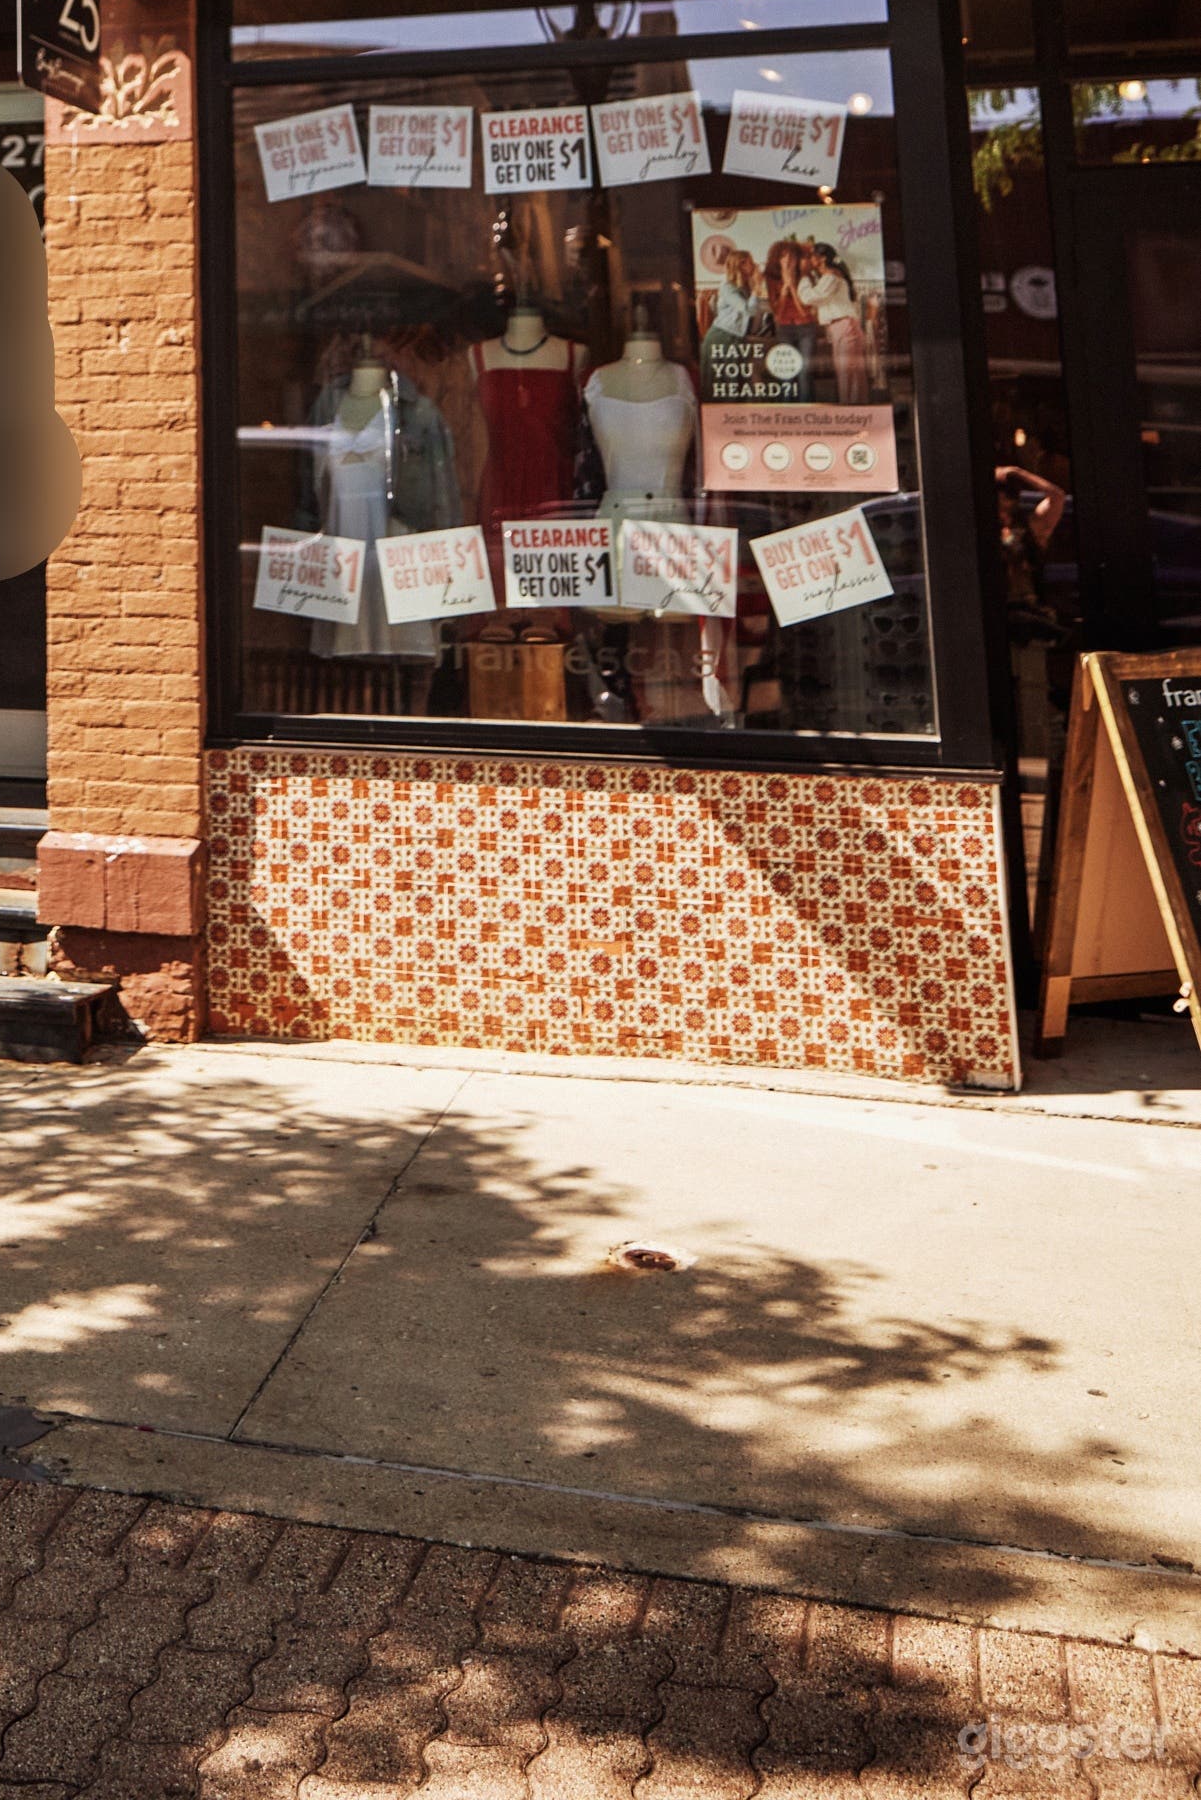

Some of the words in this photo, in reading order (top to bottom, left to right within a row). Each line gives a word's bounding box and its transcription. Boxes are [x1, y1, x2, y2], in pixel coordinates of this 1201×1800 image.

[375, 115, 405, 134] BUY
[408, 114, 437, 134] ONE
[488, 114, 584, 139] CLEARANCE
[601, 110, 631, 133] BUY
[634, 105, 666, 129] ONE
[671, 101, 701, 145] $1
[738, 102, 769, 124] BUY
[774, 107, 806, 129] ONE
[262, 130, 291, 149] BUY
[294, 120, 322, 141] ONE
[327, 112, 357, 155] $1
[378, 137, 403, 156] GET
[408, 137, 436, 157] ONE
[442, 116, 468, 157] $1
[607, 133, 634, 155] GET
[638, 129, 669, 151] ONE
[738, 124, 768, 147] GET
[771, 129, 806, 152] ONE
[810, 113, 841, 158] $1
[270, 147, 297, 170] GET
[299, 143, 327, 164] ONE
[491, 141, 520, 163] BUY
[524, 140, 554, 160] ONE
[560, 137, 587, 180] $1
[496, 163, 523, 184] GET
[525, 161, 556, 183] ONE
[711, 343, 764, 358] HAVE
[712, 362, 753, 378] YOU
[712, 382, 798, 397] HEARD?!
[723, 413, 747, 425] Join
[751, 412, 772, 425] The
[803, 412, 832, 425] Club
[835, 413, 873, 427] today!
[268, 535, 294, 560] BUY
[300, 541, 329, 564] ONE
[511, 527, 608, 548] CLEARANCE
[631, 531, 662, 551] BUY
[666, 533, 698, 555] ONE
[763, 538, 795, 568] BUY
[799, 530, 833, 557] ONE
[837, 520, 875, 566] $1
[386, 545, 415, 568] BUY
[419, 541, 448, 562] ONE
[454, 535, 485, 580] $1
[513, 553, 543, 574] BUY
[549, 552, 579, 573] ONE
[634, 555, 660, 577] GET
[665, 557, 697, 580] ONE
[705, 538, 731, 583] $1
[268, 560, 295, 581] GET
[298, 566, 327, 588] ONE
[333, 551, 359, 592] $1
[393, 569, 420, 590] GET
[424, 564, 452, 586] ONE
[585, 552, 612, 597] $1
[775, 563, 805, 590] GET
[808, 553, 840, 581] ONE
[519, 577, 547, 597] GET
[550, 576, 580, 597] ONE
